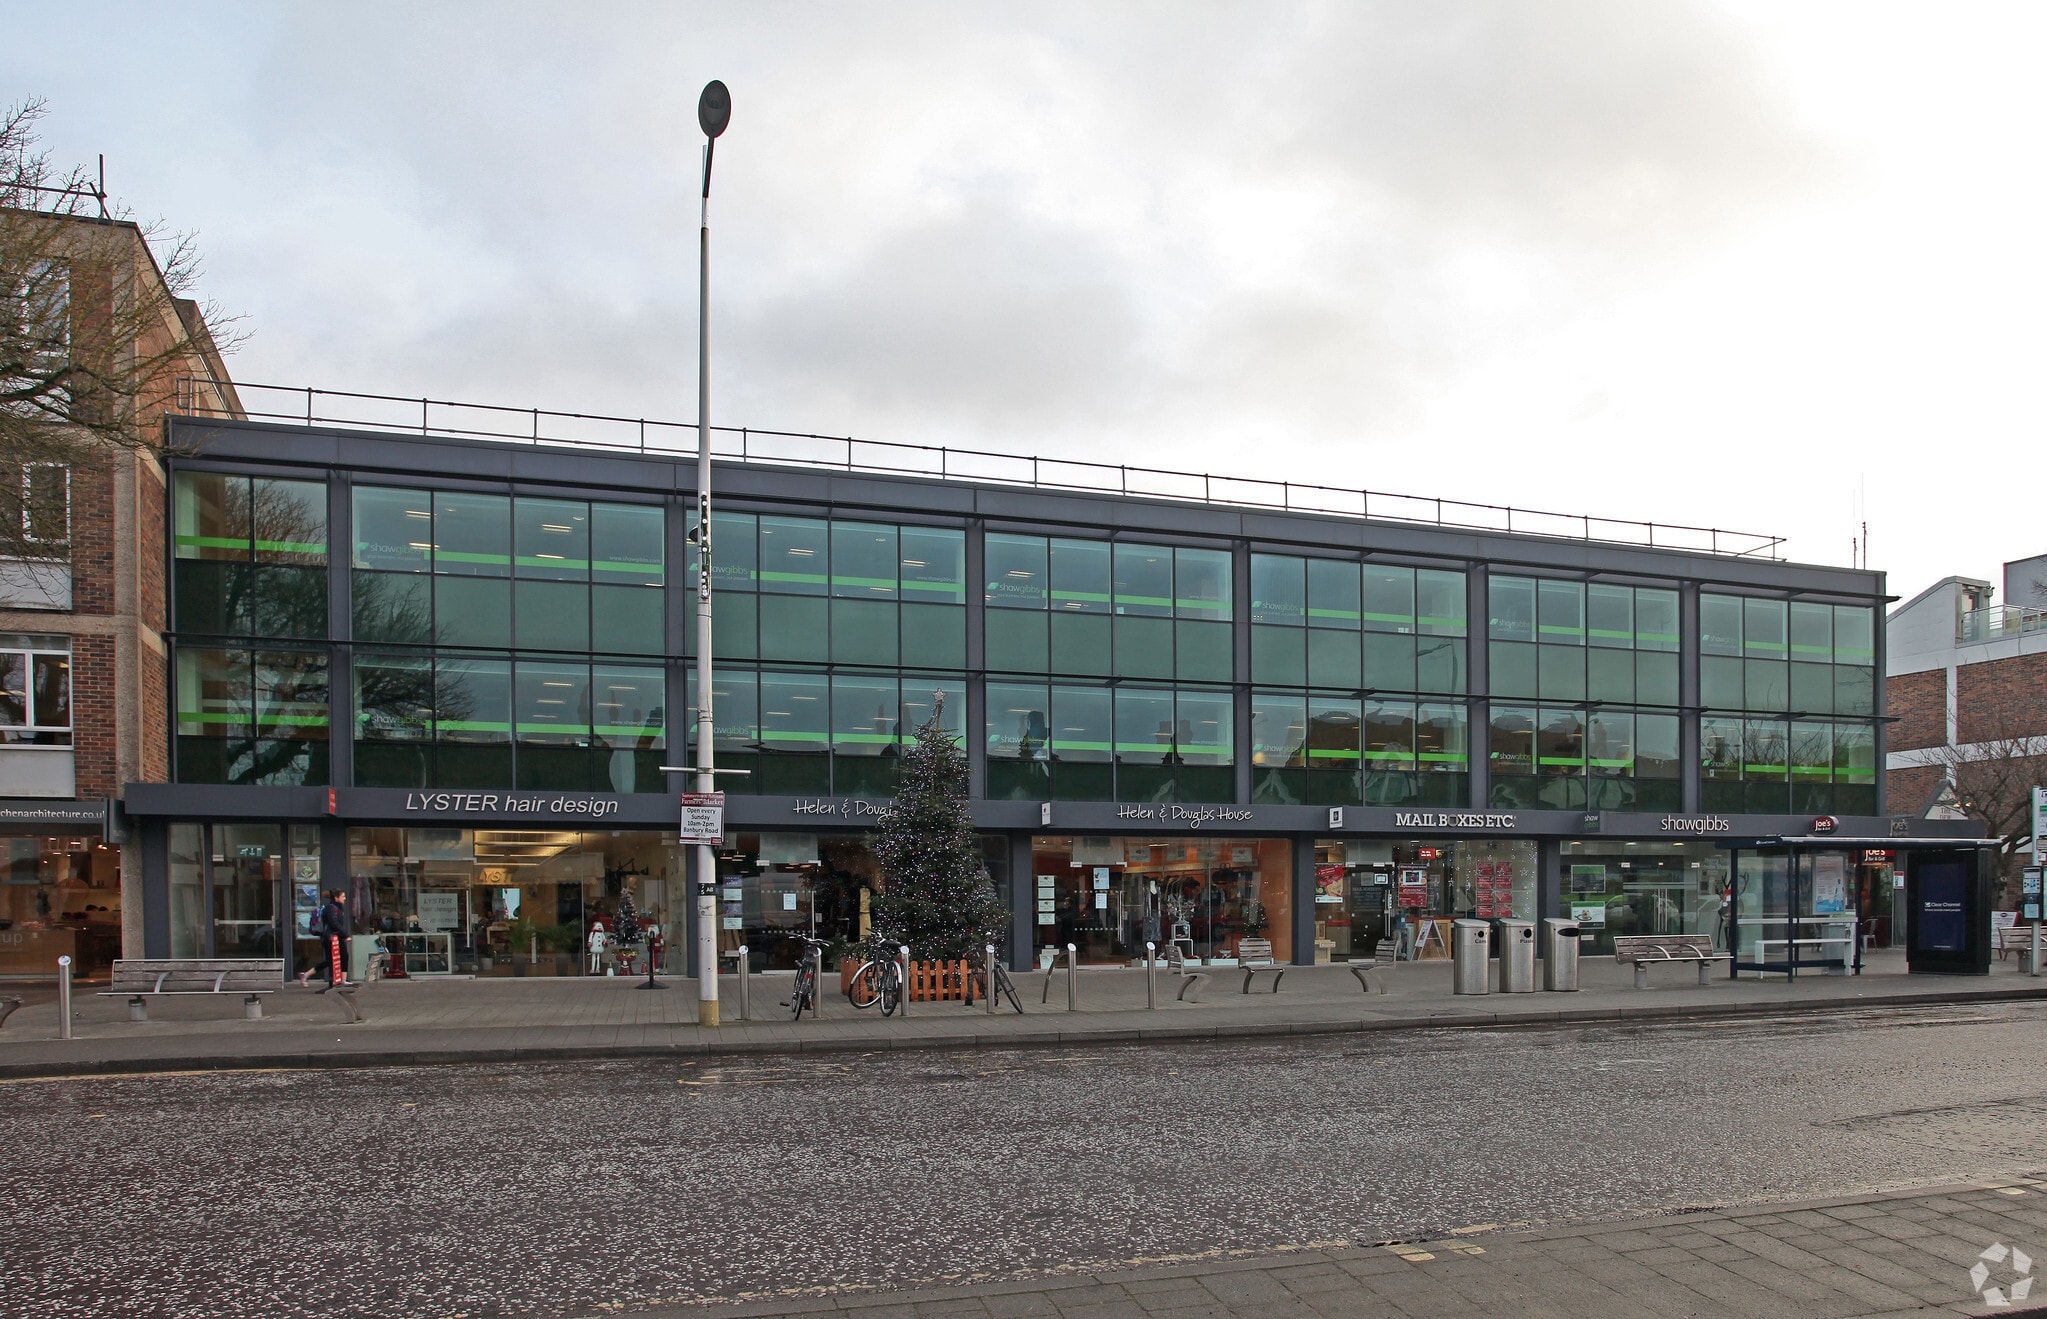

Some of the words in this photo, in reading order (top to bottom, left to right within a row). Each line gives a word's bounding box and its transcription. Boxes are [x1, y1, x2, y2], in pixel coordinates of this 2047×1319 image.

[713, 564, 747, 575] awgibbs
[713, 725, 749, 736] awgibbs
[406, 793, 499, 811] LYSTER
[504, 795, 545, 812] hair
[550, 797, 618, 817] design
[793, 798, 836, 815] Helen
[841, 798, 851, 818] &
[855, 800, 894, 824] Dougl
[1117, 804, 1154, 819] Helen
[1159, 803, 1168, 823] &
[1170, 805, 1215, 829] Douglas
[1216, 806, 1253, 821] House
[1395, 813, 1436, 827] MAIL
[1438, 814, 1484, 828] BOXES
[1661, 815, 1729, 835] shawgibbs
[1815, 819, 1831, 831] Joe's
[1890, 819, 1908, 837] Joe's
[1865, 849, 1886, 861] Joes
